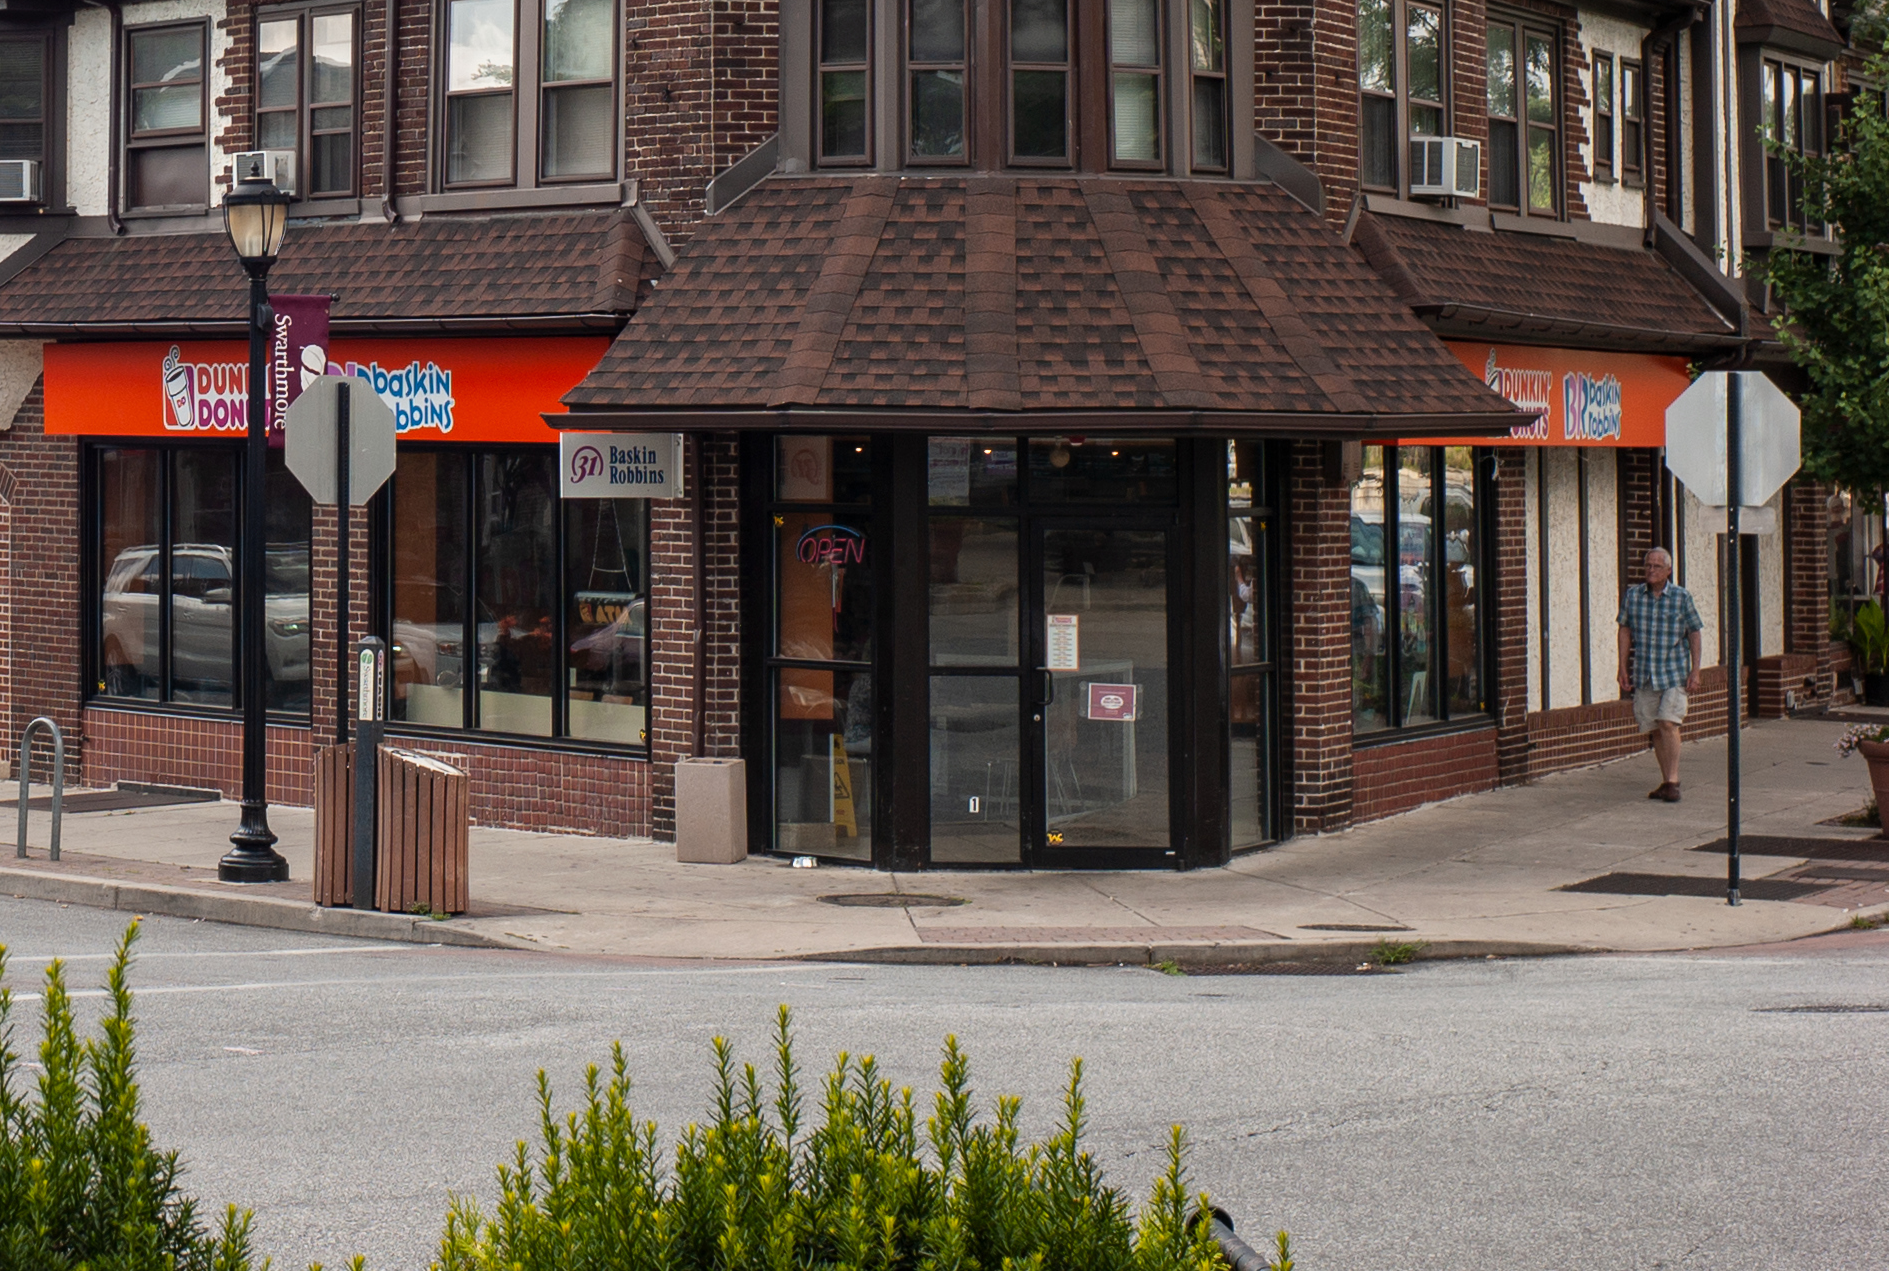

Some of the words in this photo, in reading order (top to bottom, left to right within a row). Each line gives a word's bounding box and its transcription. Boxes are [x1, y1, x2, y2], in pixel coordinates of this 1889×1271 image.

[197, 366, 271, 396] DUN
[274, 313, 295, 429] Swarthmore
[372, 363, 451, 397] baskin
[1504, 370, 1551, 403] DUNKIN'
[1589, 375, 1621, 405] baskin
[198, 399, 270, 428] DON
[395, 397, 452, 431] bbins
[1588, 411, 1621, 437] robbins
[609, 445, 657, 465] Baskin
[609, 465, 665, 485] Robbins
[800, 537, 866, 565] OPEN
